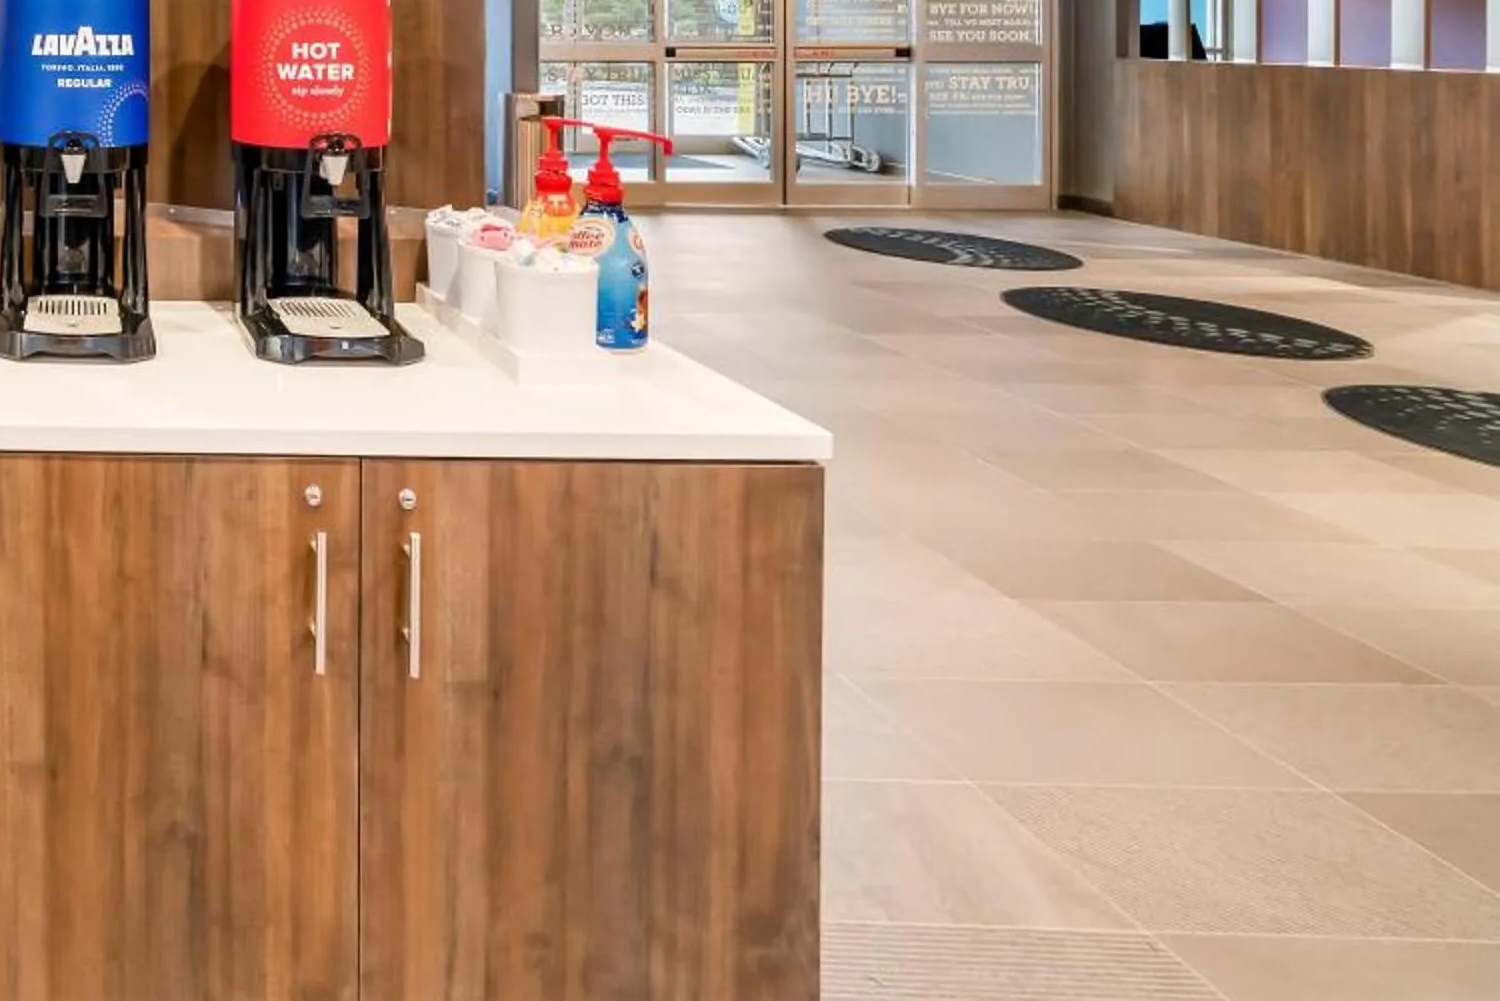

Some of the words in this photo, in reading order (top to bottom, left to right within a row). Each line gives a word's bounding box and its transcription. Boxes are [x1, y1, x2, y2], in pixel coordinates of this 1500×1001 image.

[930, 2, 957, 14] BYE
[960, 2, 988, 14] FOR
[991, 2, 1033, 15] NOW!
[31, 25, 134, 56] LAVAZZA
[930, 30, 954, 42] SEE
[956, 30, 985, 42] YOU
[291, 42, 341, 59] HOT
[276, 63, 355, 80] WATER
[57, 78, 111, 88] REGULAR
[948, 76, 991, 90] STAY
[995, 76, 1030, 90] TRU
[846, 85, 897, 103] BYE!
